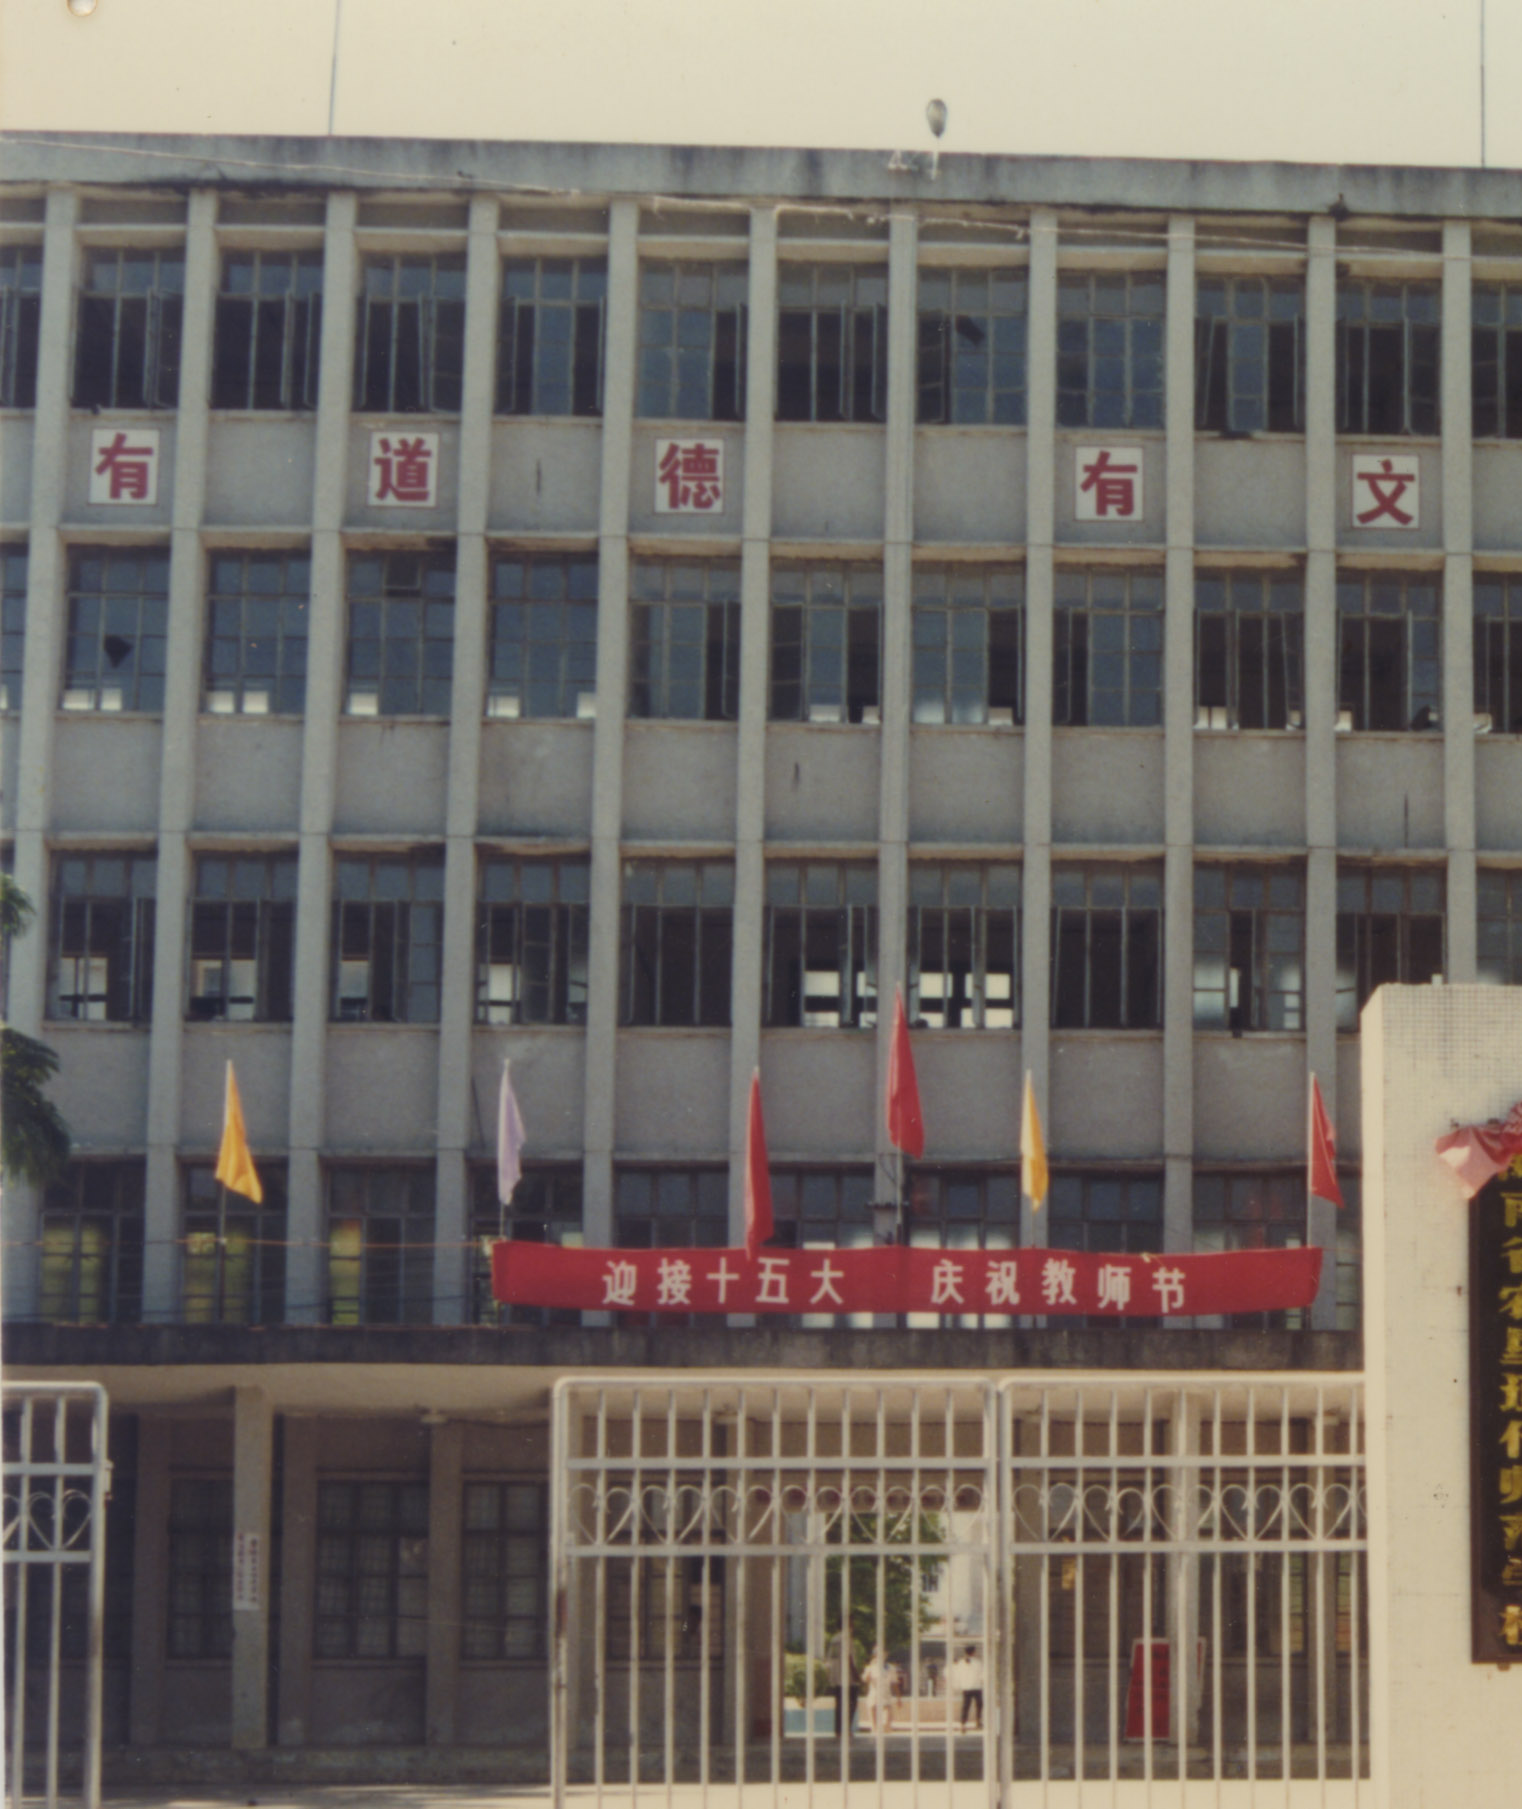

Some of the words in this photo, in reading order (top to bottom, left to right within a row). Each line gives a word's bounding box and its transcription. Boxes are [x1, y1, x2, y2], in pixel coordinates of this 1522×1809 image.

[602, 1257, 845, 1305] 迎接十五大
[930, 1258, 1186, 1314] 庆祝教师节
